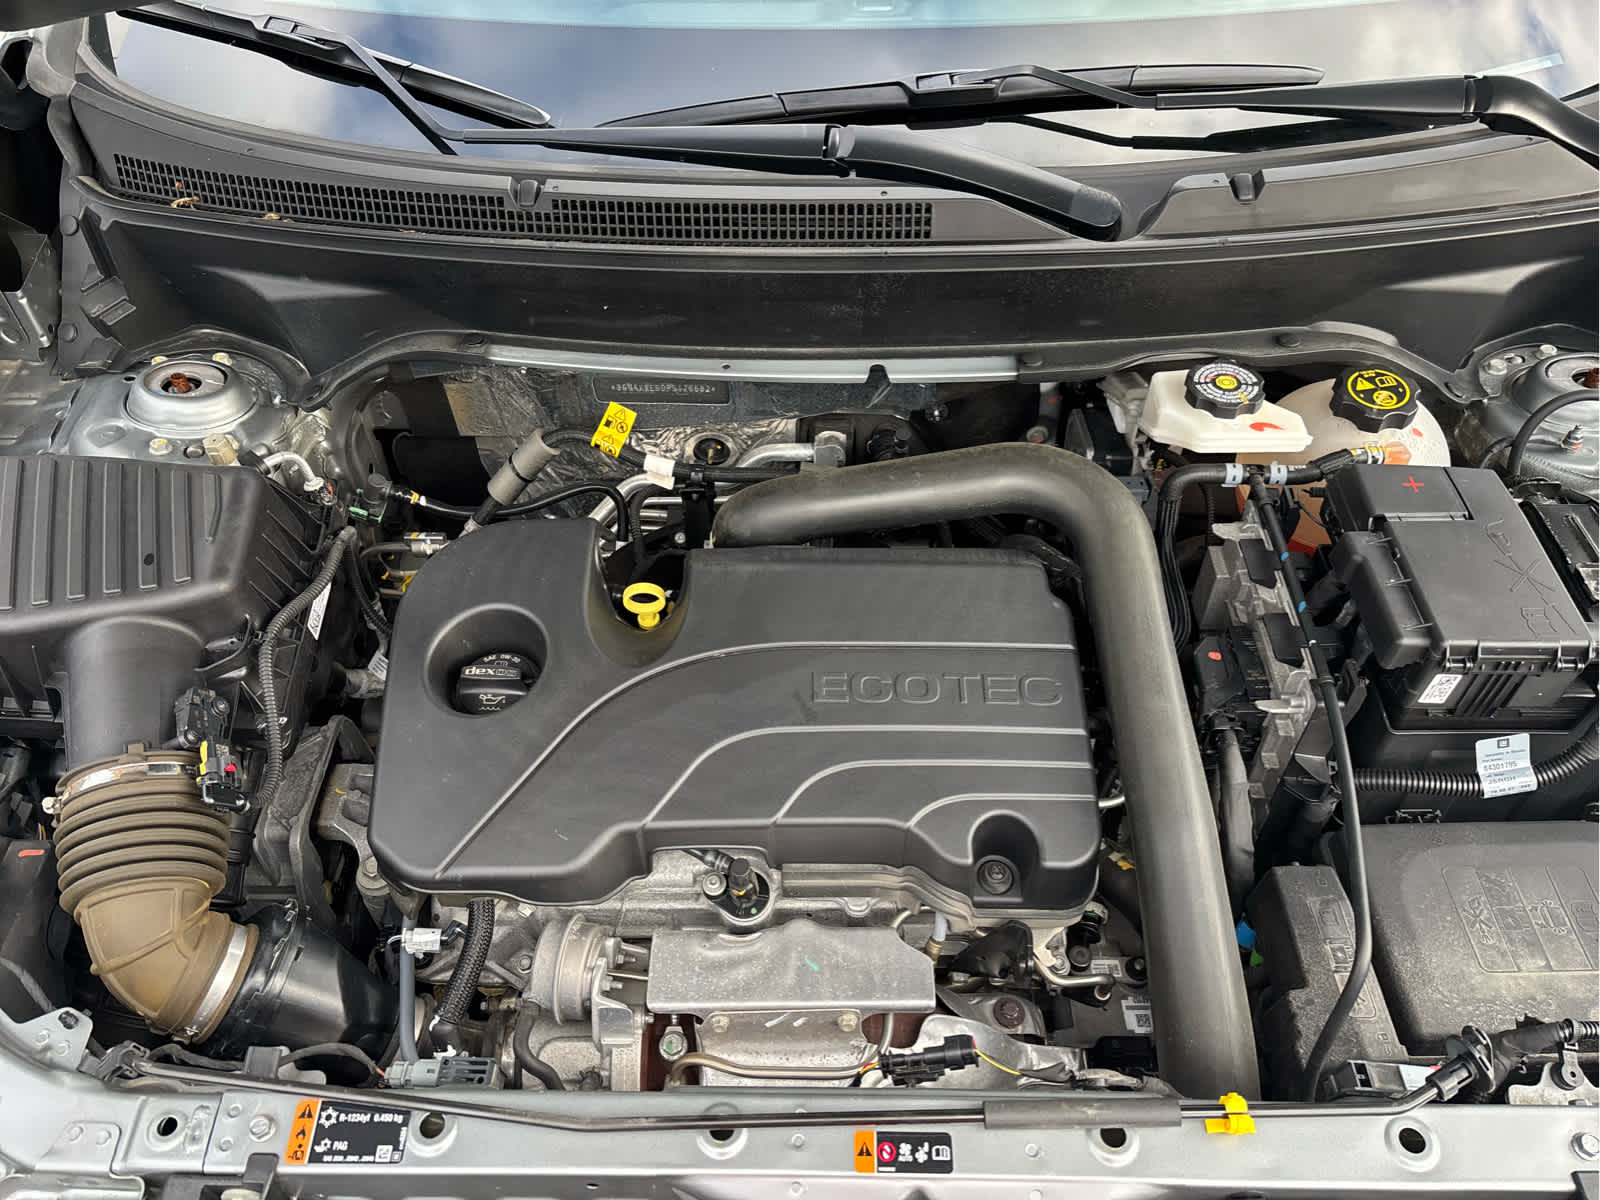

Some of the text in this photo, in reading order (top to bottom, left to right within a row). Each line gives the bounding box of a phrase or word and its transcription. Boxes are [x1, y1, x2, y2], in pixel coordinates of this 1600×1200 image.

[483, 654, 497, 662] SAE
[811, 671, 1064, 706] ECOTEC
[339, 1113, 371, 1124] R-1234yf
[393, 1113, 404, 1124] kg
[332, 1141, 349, 1150] PAG
